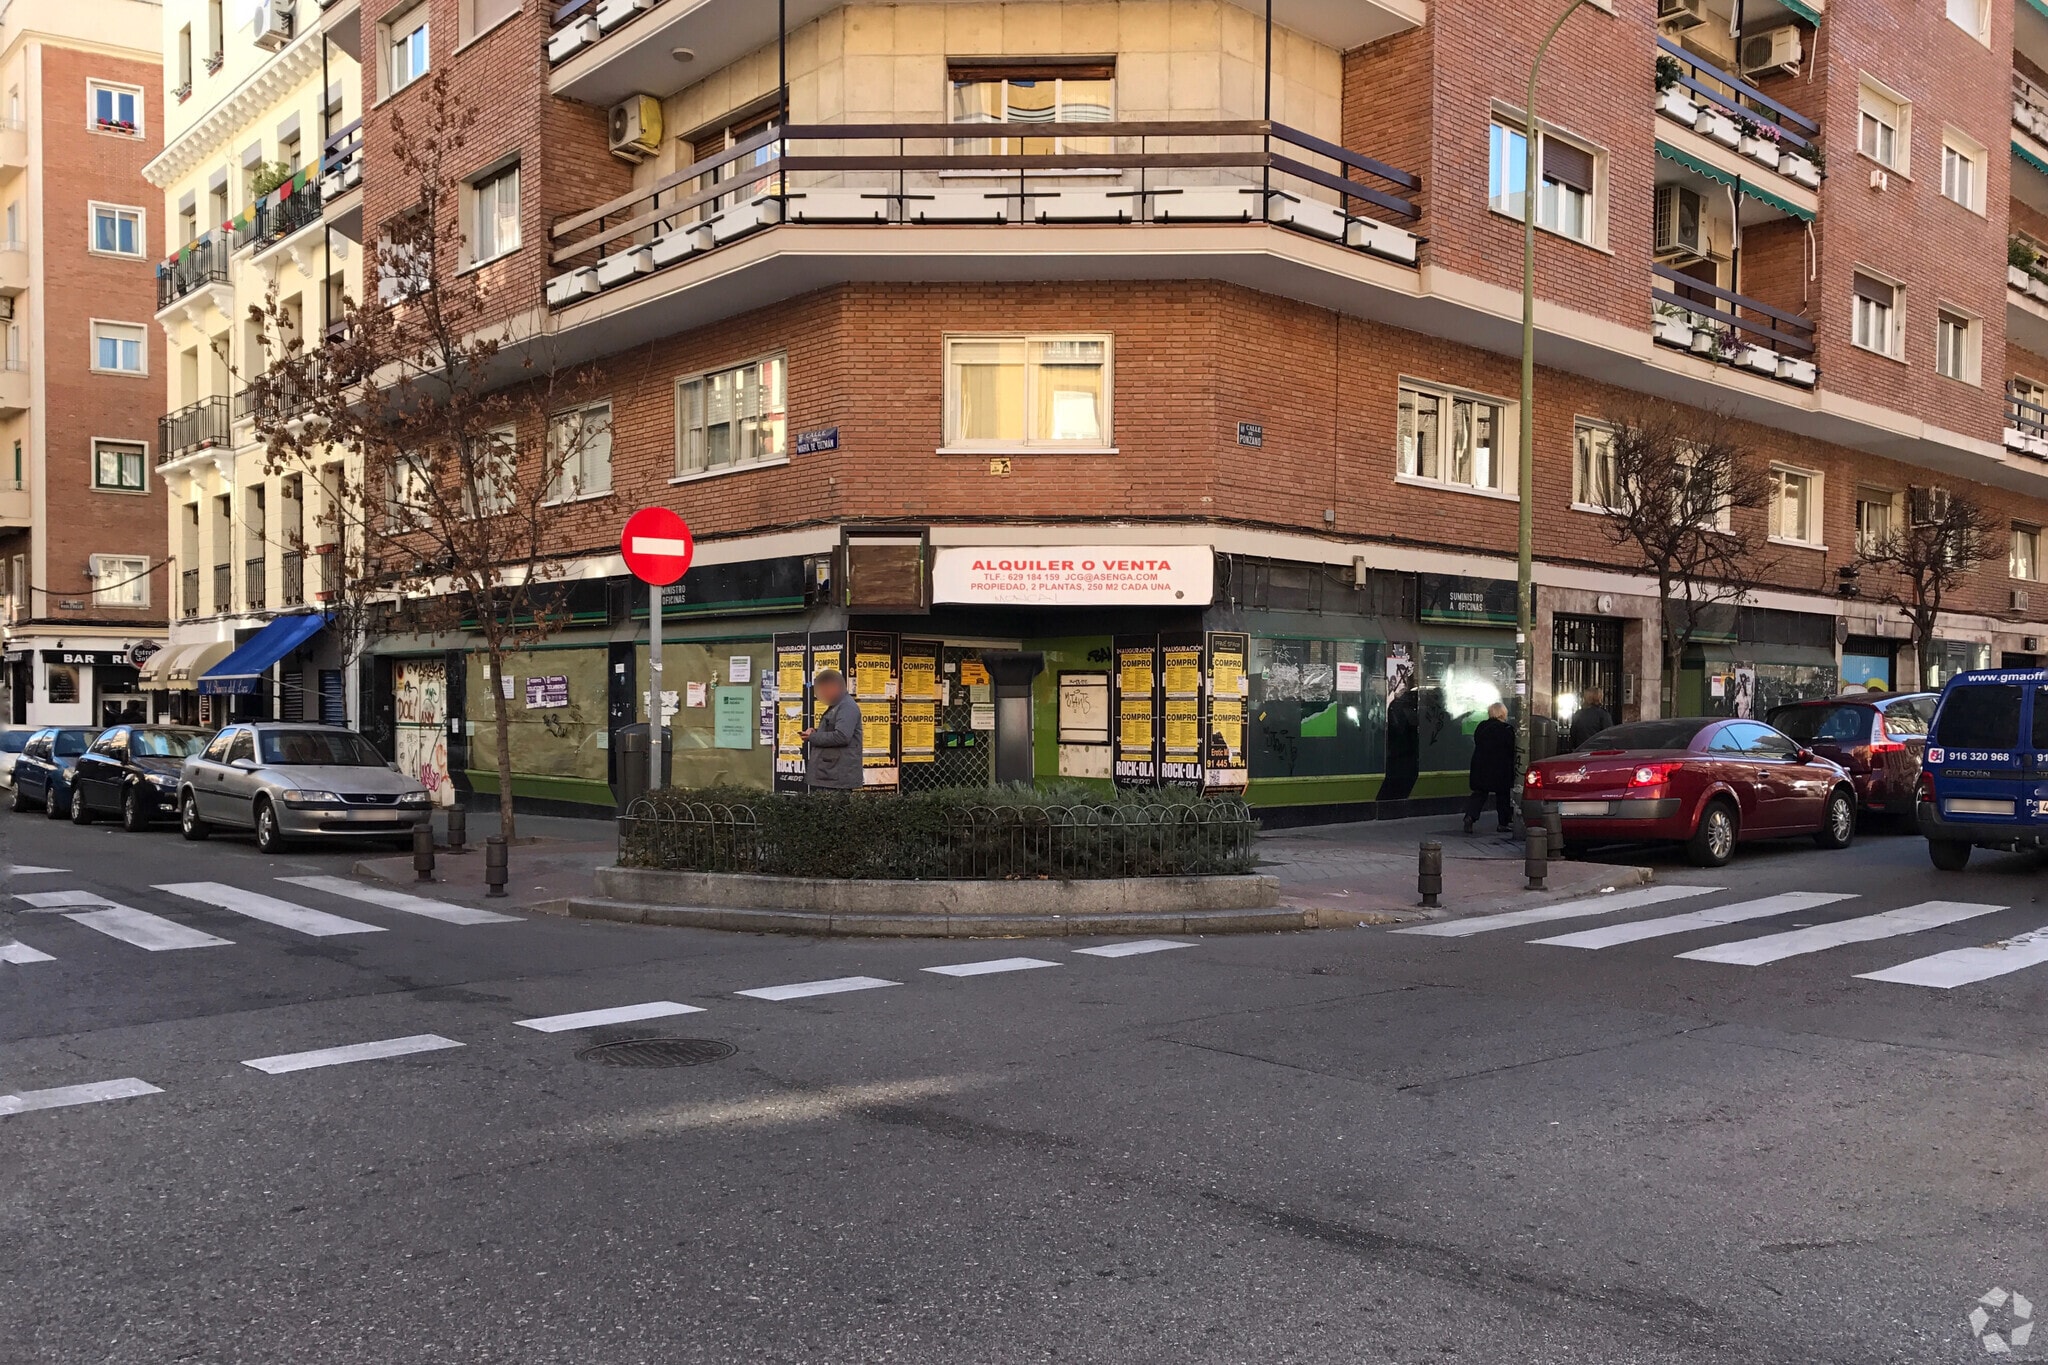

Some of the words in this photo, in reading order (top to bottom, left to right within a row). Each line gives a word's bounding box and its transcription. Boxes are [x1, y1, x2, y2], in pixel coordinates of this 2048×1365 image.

[971, 560, 1075, 571] ALQUILER
[1081, 560, 1096, 571] O
[1102, 560, 1172, 571] VENTA
[1008, 573, 1024, 581] 629
[1027, 573, 1041, 581] 184
[1045, 573, 1060, 581] 159
[1065, 573, 1158, 582] JCG@ASENGA.COM
[661, 585, 685, 595] MINISTRO
[970, 583, 1029, 591] PROPIEDAD,
[1031, 583, 1036, 591] 2
[1039, 583, 1085, 592] PLANTAS,
[1087, 583, 1103, 591] 250
[1105, 583, 1119, 591] M2
[1121, 583, 1148, 591] CADA
[1150, 583, 1171, 591] UNA
[1449, 592, 1484, 602] SUMINISTRO
[1449, 602, 1455, 610] A
[1457, 602, 1483, 612] OFICINAS
[63, 654, 95, 664] BAR
[814, 657, 839, 668] COMPRO
[1121, 659, 1151, 668] COMPRO
[1166, 658, 1197, 667] COMPRO
[1214, 659, 1242, 668] COMPRO
[779, 660, 802, 668] COMPRO
[857, 660, 890, 669] COMPRO
[903, 662, 934, 671] COMPRO
[1968, 671, 2045, 683] www.gmaoff
[862, 715, 890, 723] OMPRO
[902, 715, 934, 723] COMPRO
[1121, 713, 1151, 721] COMPRO
[1166, 713, 1197, 722] COMPRO
[1213, 714, 1241, 722] COMPRO
[1949, 752, 1967, 761] 916
[1970, 752, 1988, 761] 320
[1990, 752, 2010, 762] 968
[2037, 753, 2048, 762] 91
[1206, 759, 1214, 768] 91
[1216, 759, 1228, 768] 445
[1945, 769, 1991, 777] CITROËN
